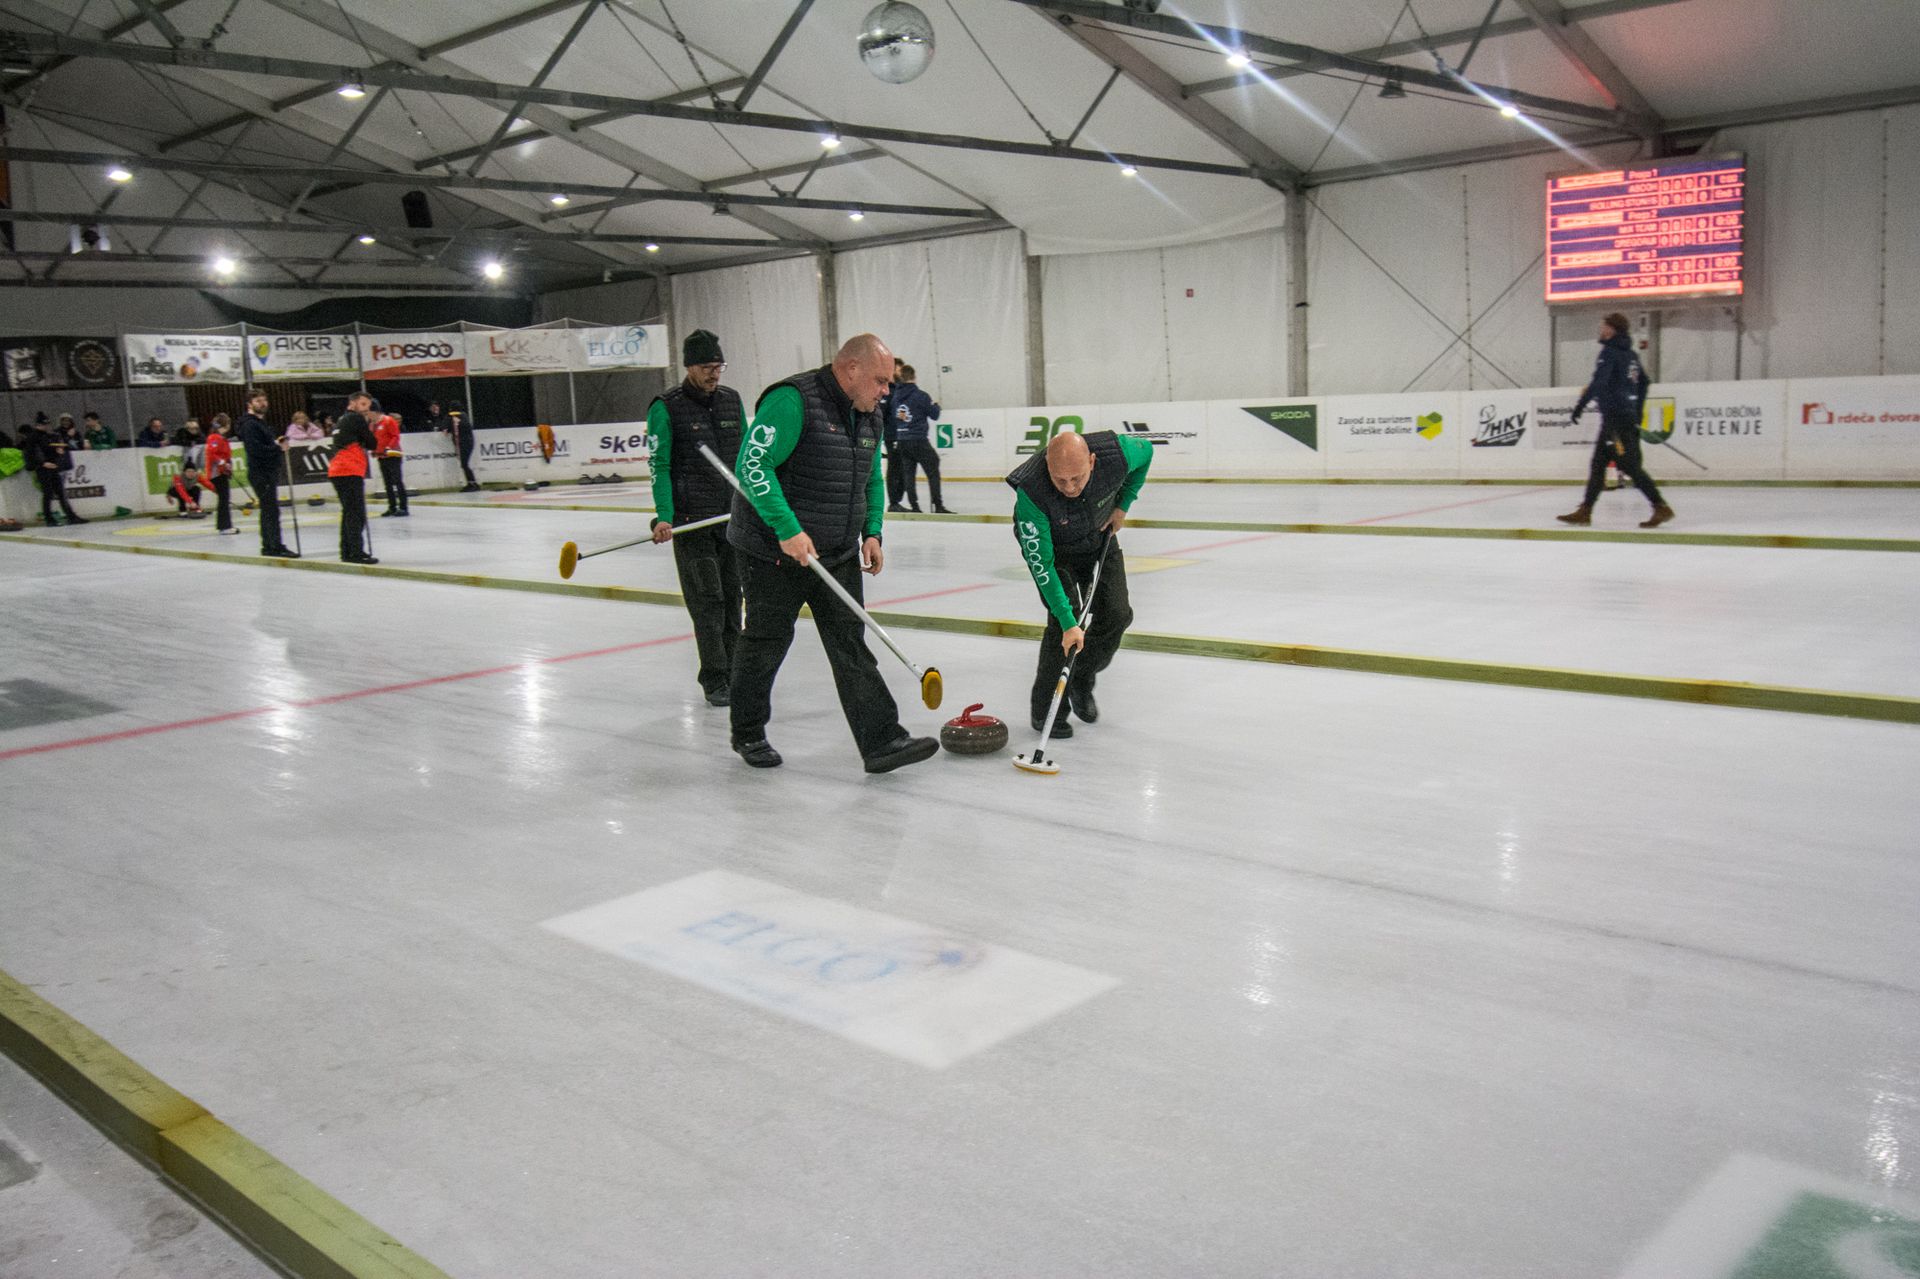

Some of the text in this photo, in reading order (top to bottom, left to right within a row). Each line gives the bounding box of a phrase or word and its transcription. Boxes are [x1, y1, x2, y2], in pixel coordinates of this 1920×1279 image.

[275, 336, 333, 351] AKER
[588, 340, 640, 357] ELGO
[1338, 416, 1364, 425] Zavod
[1838, 411, 1876, 424] rdeča
[956, 427, 985, 440] SAVA
[1684, 420, 1762, 436] VELENJE
